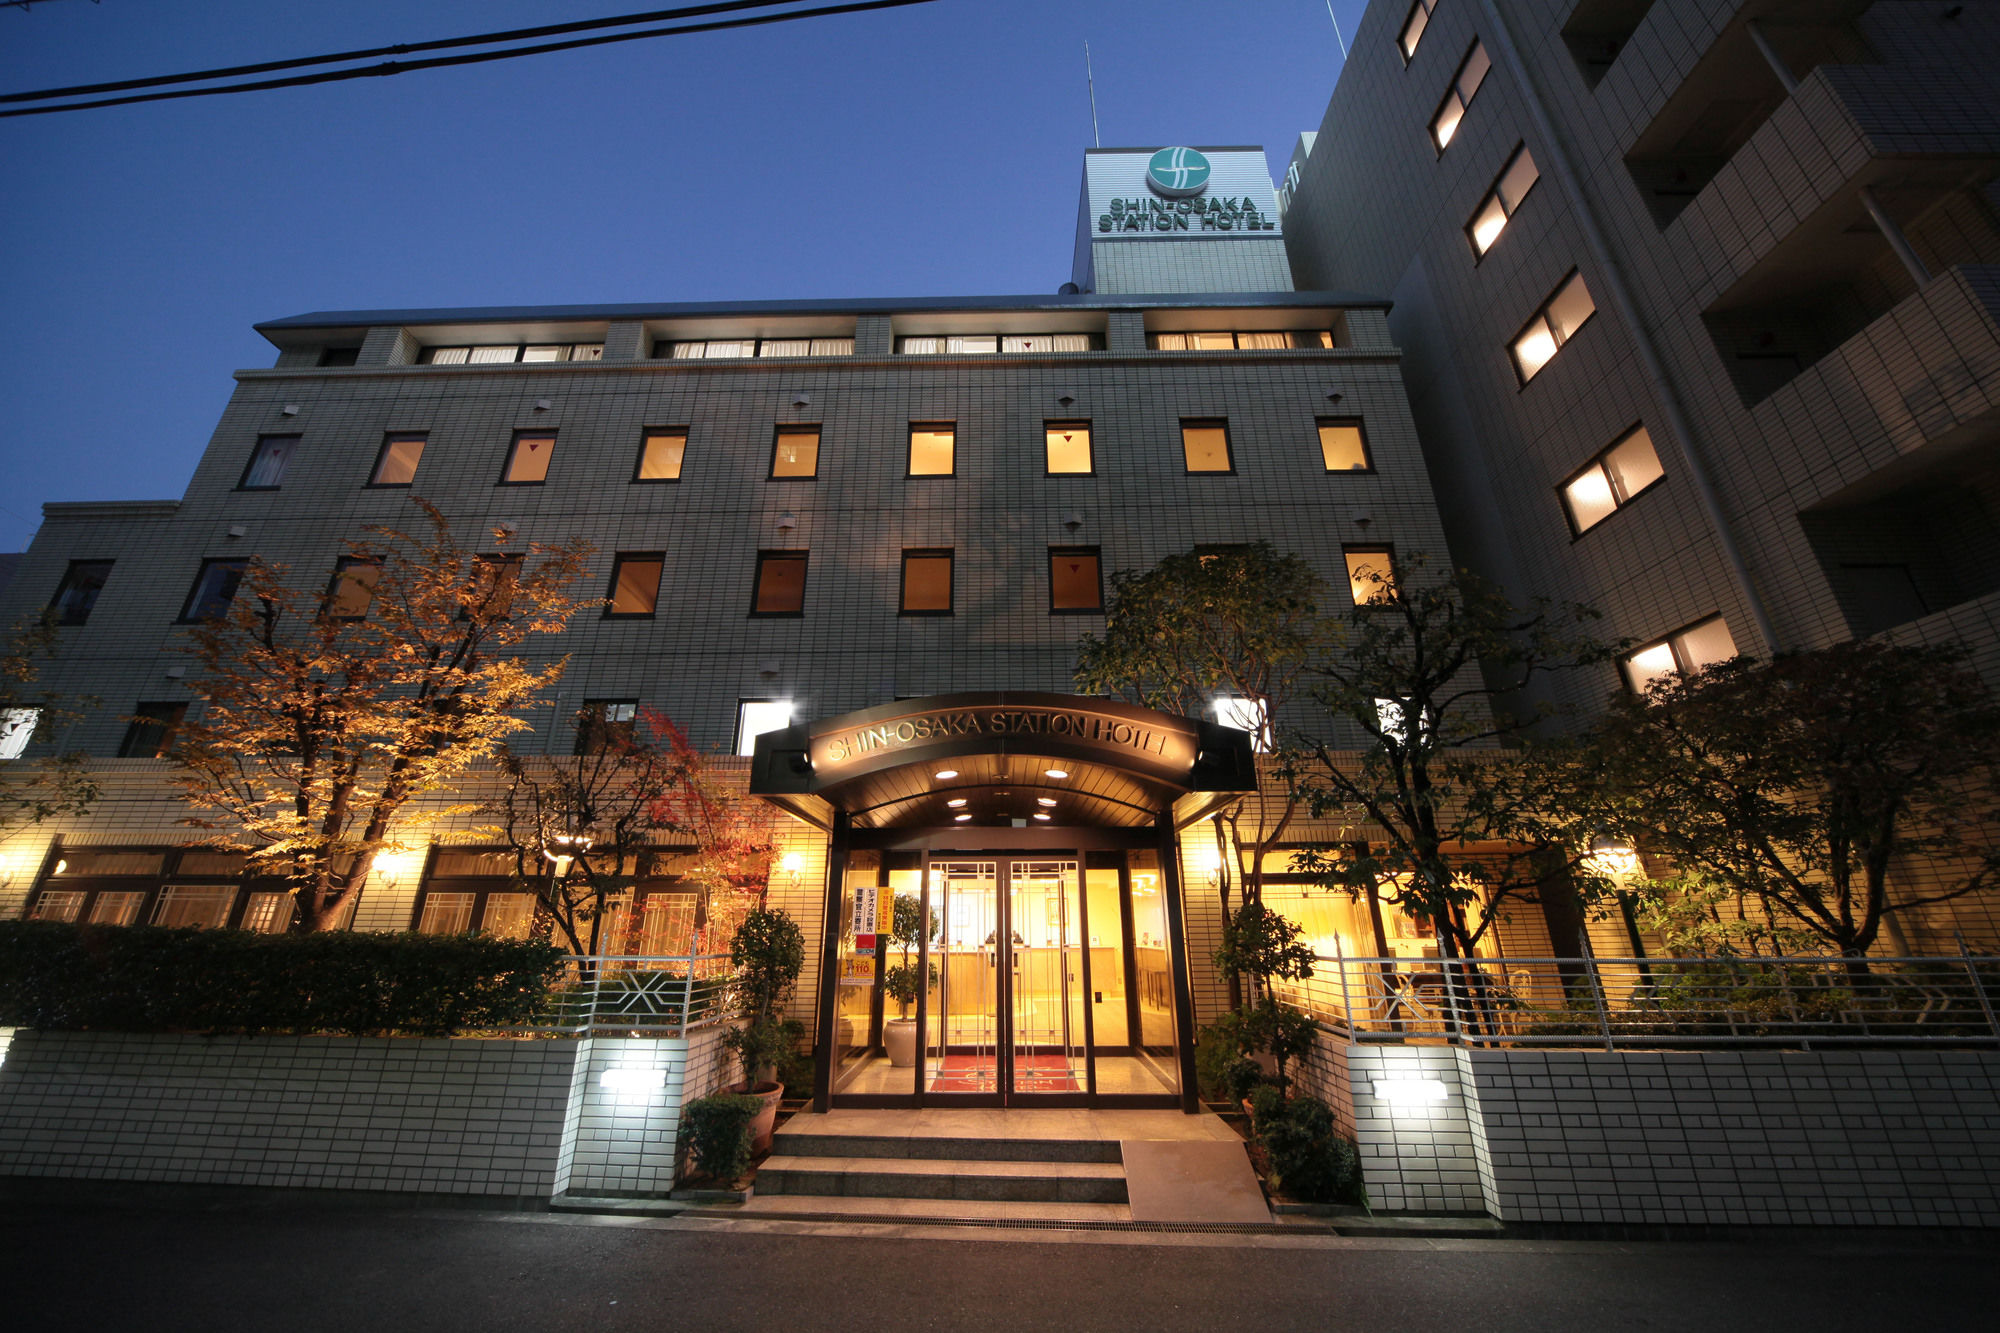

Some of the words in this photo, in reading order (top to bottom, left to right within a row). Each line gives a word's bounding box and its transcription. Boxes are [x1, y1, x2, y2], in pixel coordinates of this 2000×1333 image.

[1110, 197, 1257, 214] SHIN-OSAKA
[1099, 213, 1189, 232] STATION
[1201, 211, 1275, 231] HOTEL
[829, 713, 982, 761] SHIN-OSAKA
[991, 711, 1087, 738] STATION
